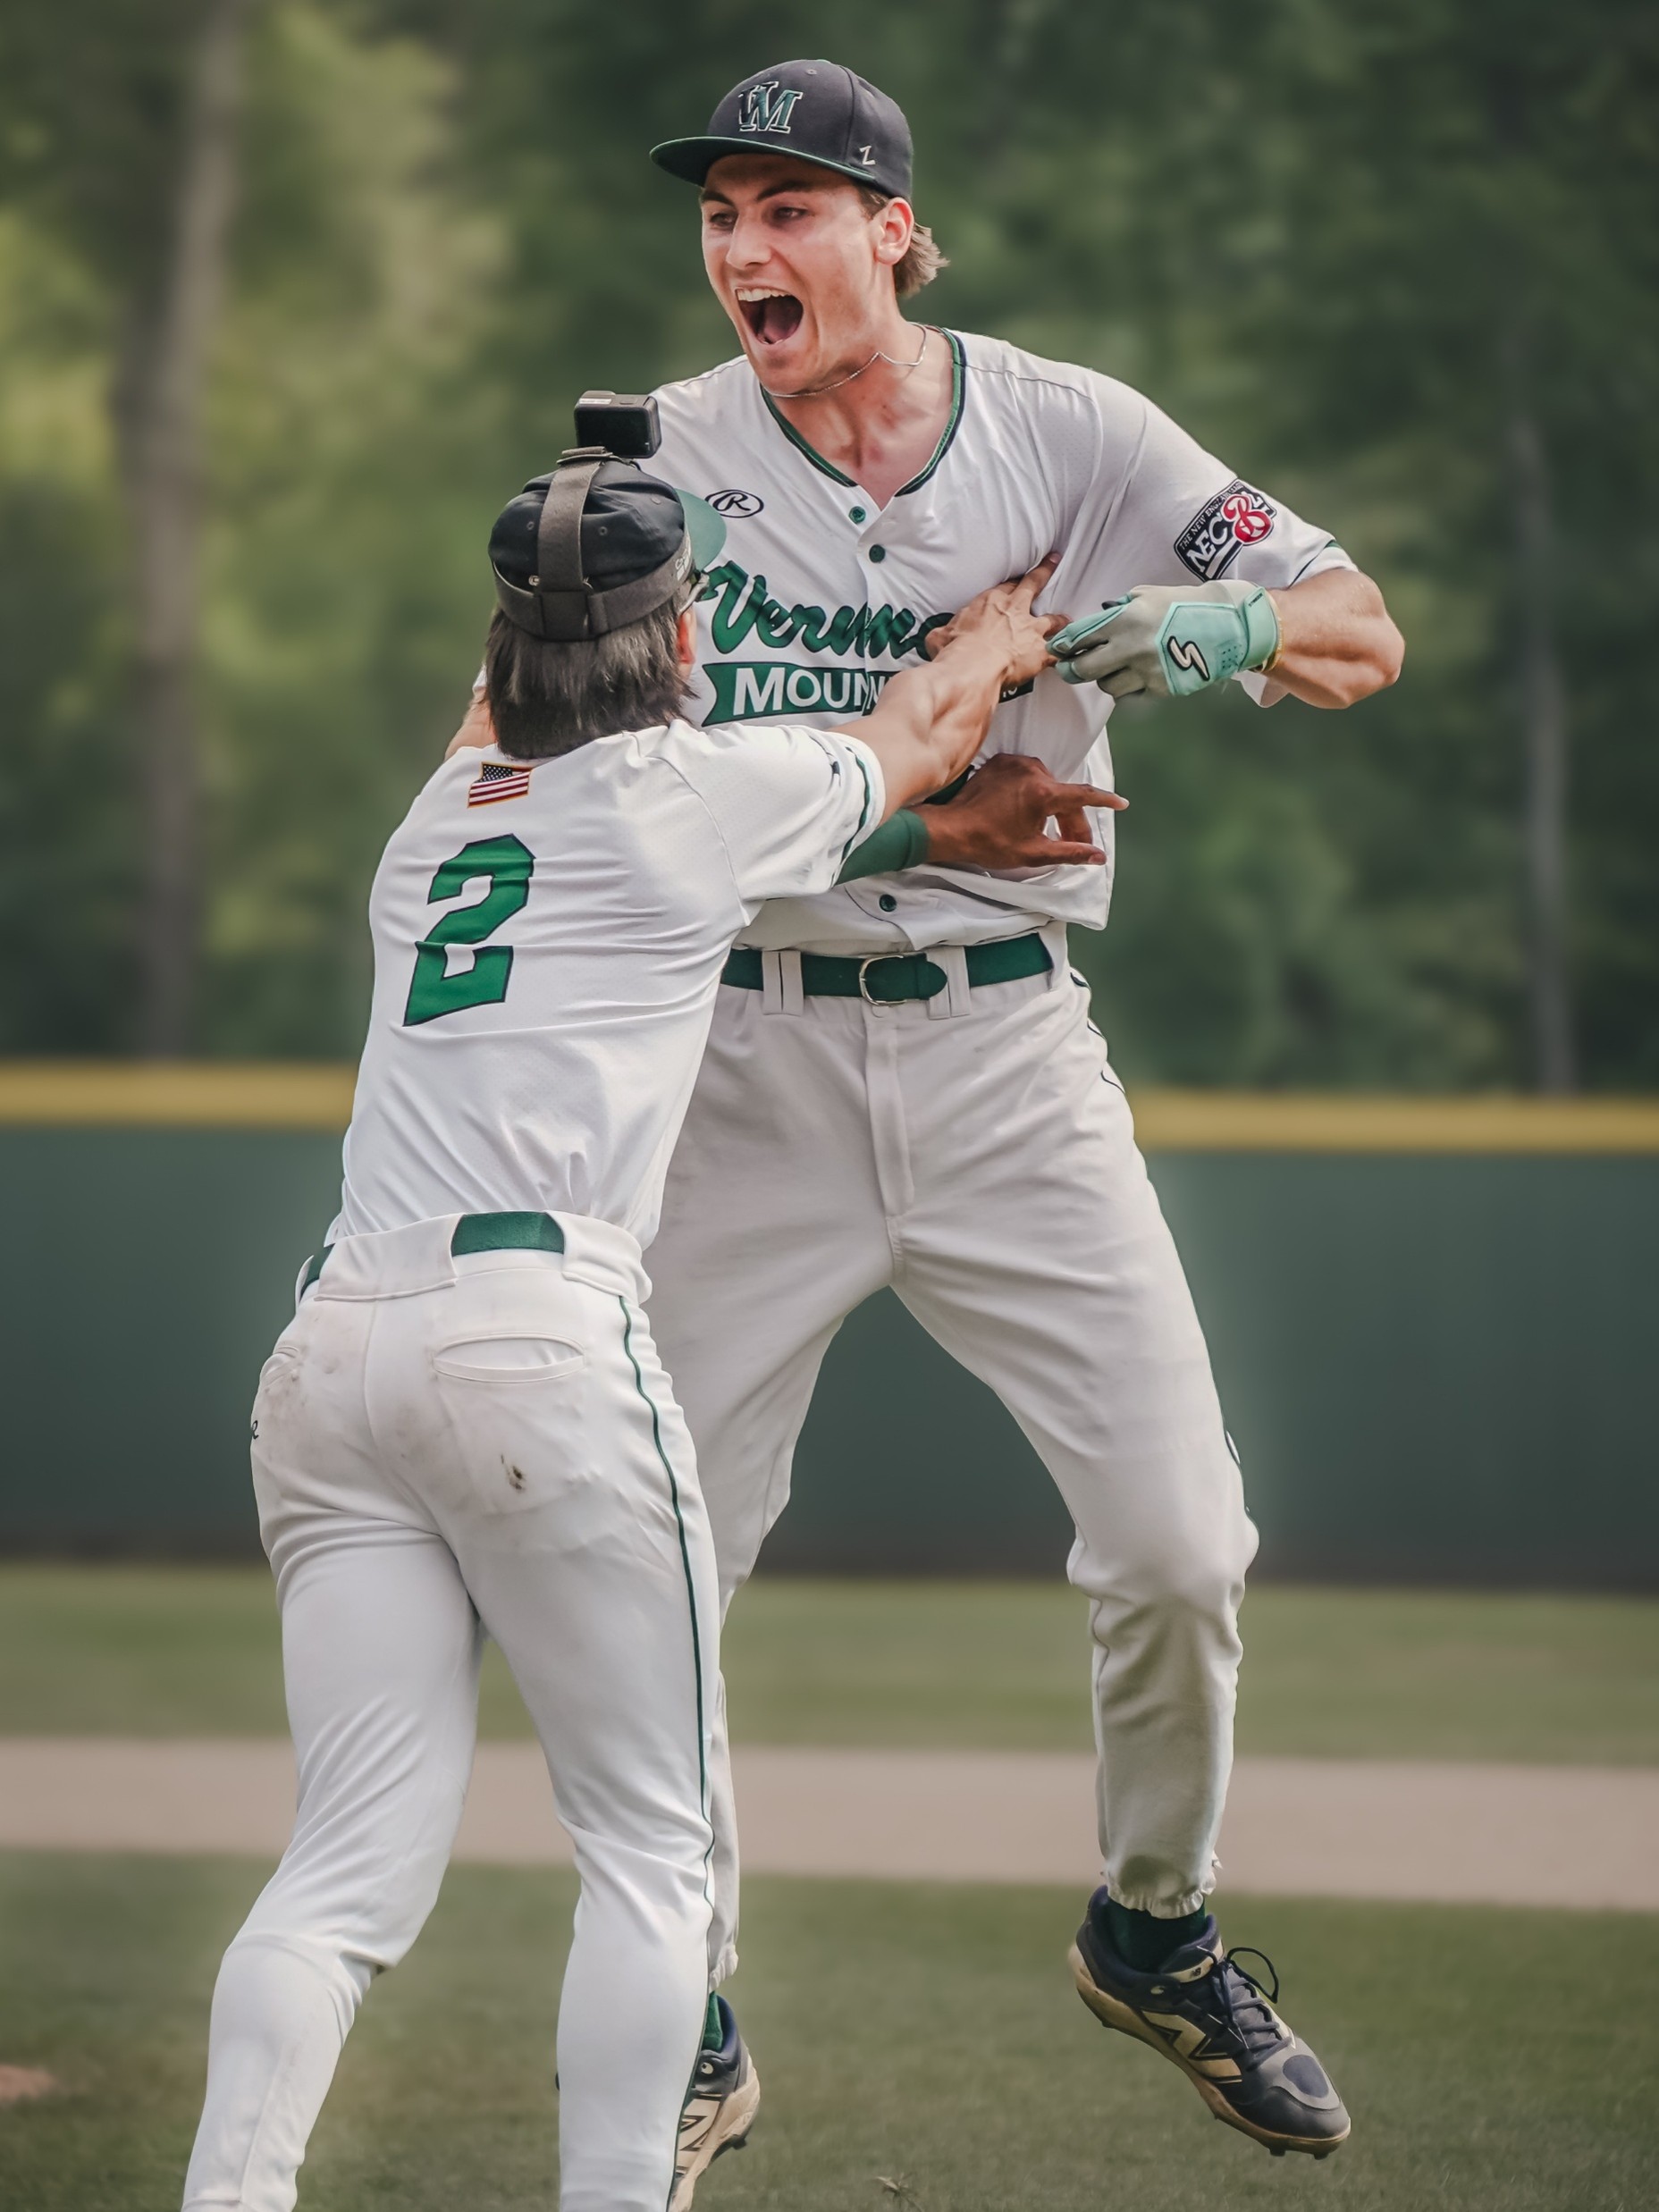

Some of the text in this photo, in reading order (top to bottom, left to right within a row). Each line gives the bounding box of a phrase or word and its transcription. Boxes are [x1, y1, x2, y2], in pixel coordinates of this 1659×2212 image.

[1179, 533, 1194, 551] THE
[1192, 514, 1207, 535] NEW
[402, 833, 536, 1027] 2
